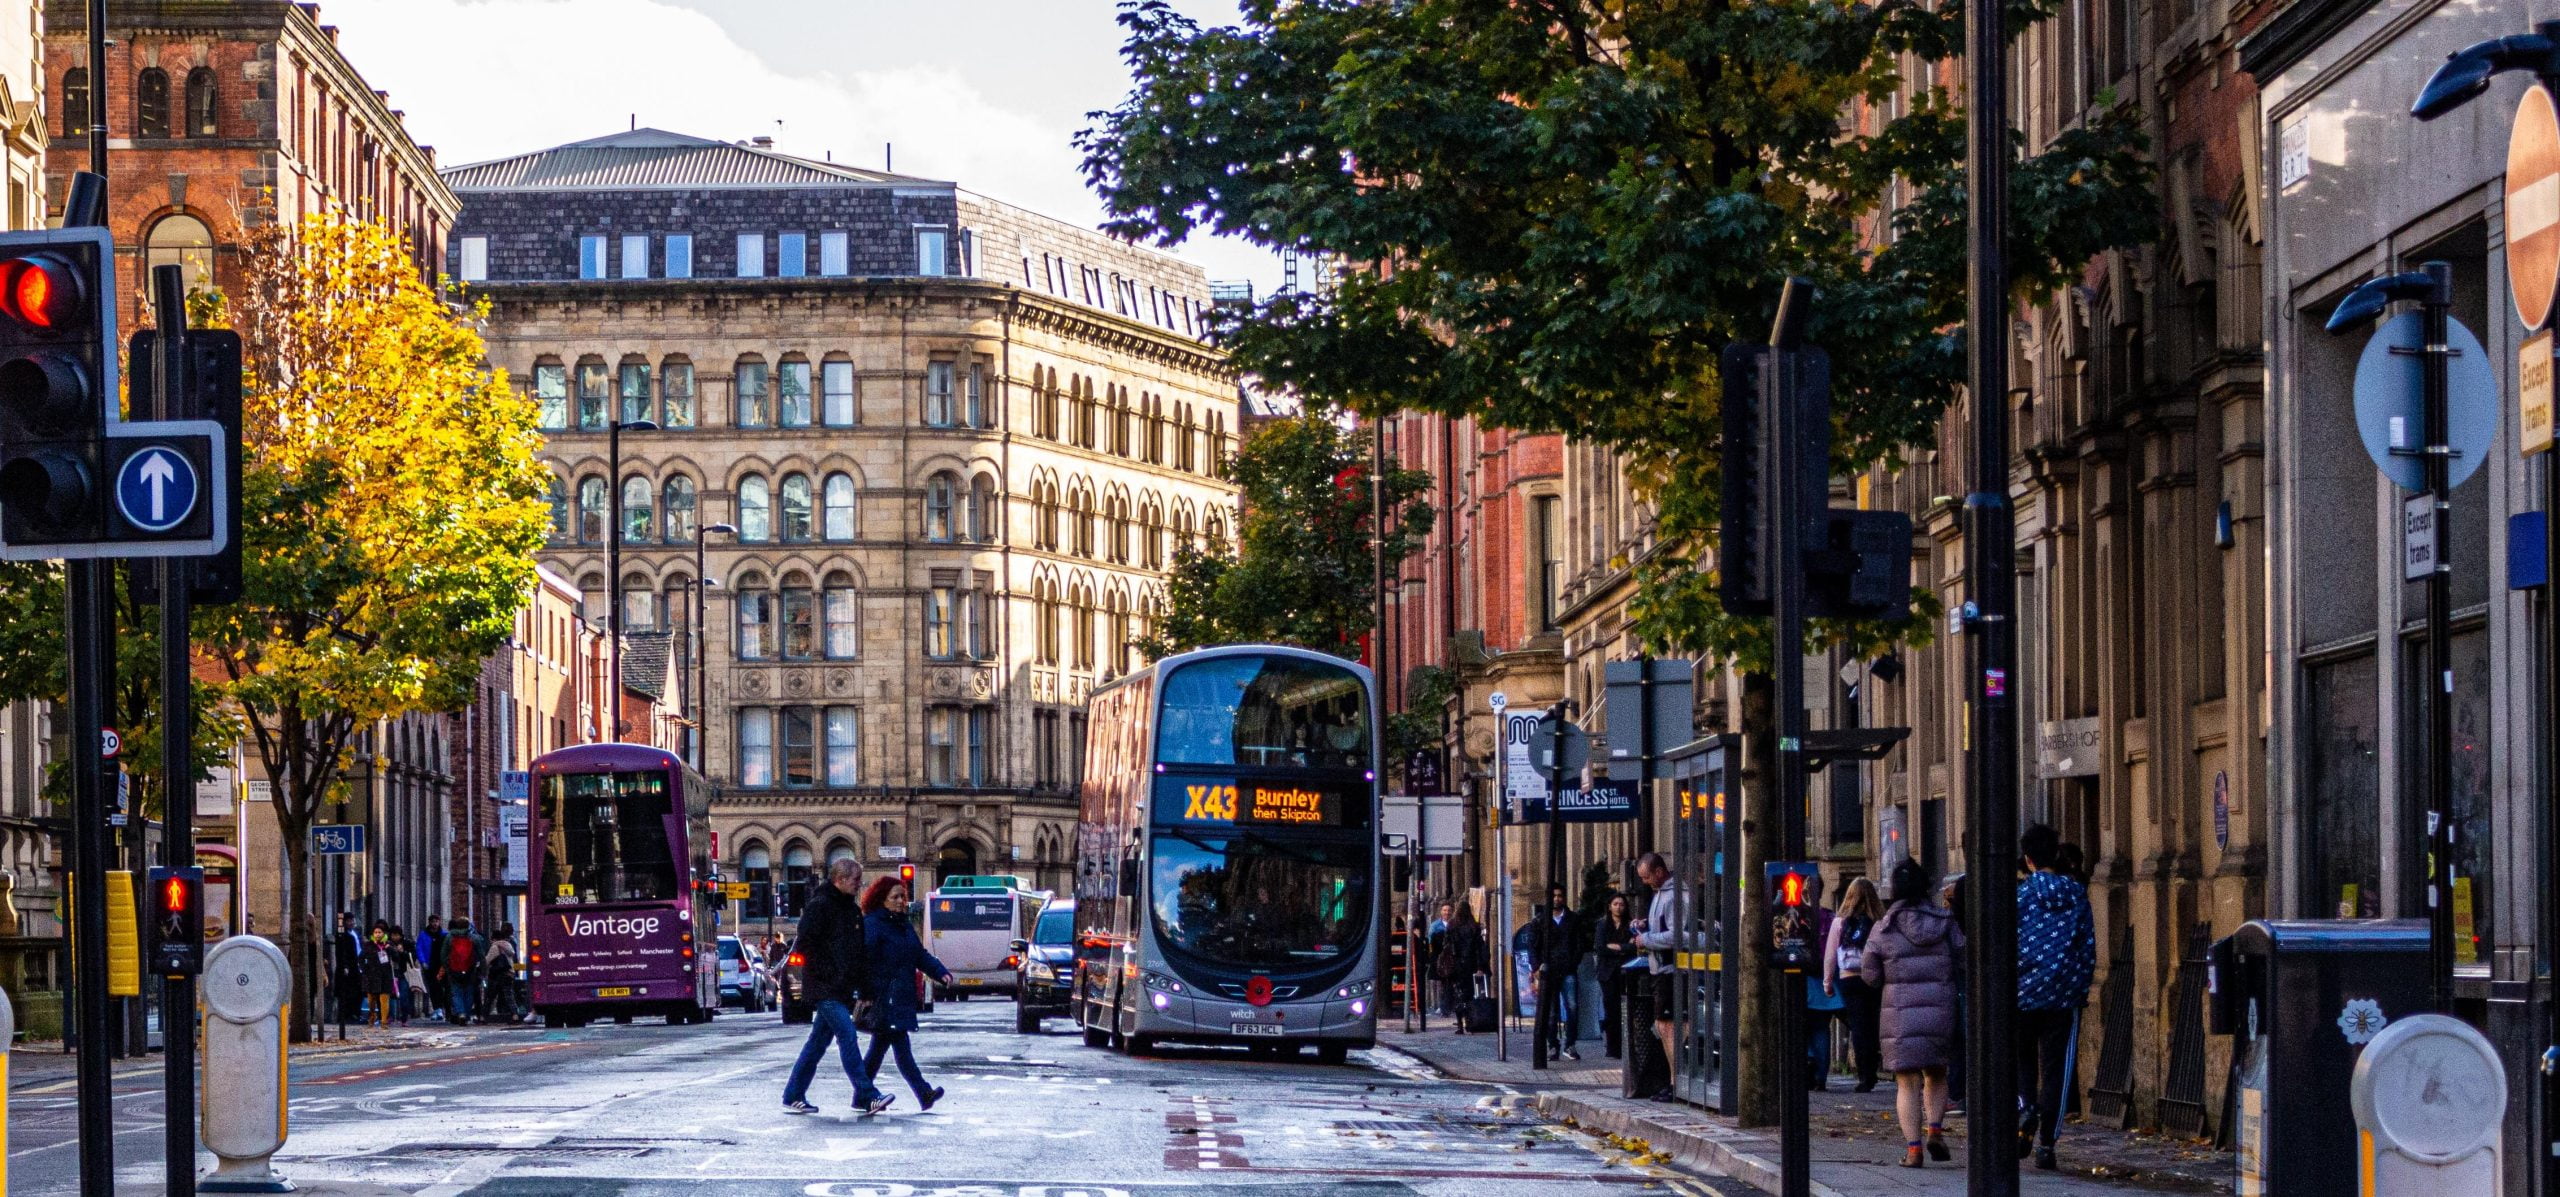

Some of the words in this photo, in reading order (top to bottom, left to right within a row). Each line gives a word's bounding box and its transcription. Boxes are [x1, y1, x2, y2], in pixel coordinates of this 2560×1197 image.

[2522, 360, 2549, 393] Except
[2524, 402, 2547, 432] trams
[2407, 511, 2432, 535] Except
[2409, 544, 2430, 565] trams
[1491, 696, 1505, 706] SG
[1184, 785, 1239, 820] X43
[1255, 788, 1321, 811] Burnley
[1545, 788, 1608, 806] PINCESS
[1609, 796, 1630, 805] HOTEL
[1253, 807, 1277, 819] then
[1280, 808, 1321, 822] Skipton
[555, 896, 579, 905] 39260
[561, 914, 659, 939] Vantage
[549, 952, 566, 960] Leigh
[639, 948, 674, 956] Manchester
[1235, 1025, 1259, 1034] BF63
[1261, 1026, 1279, 1035] HCL
